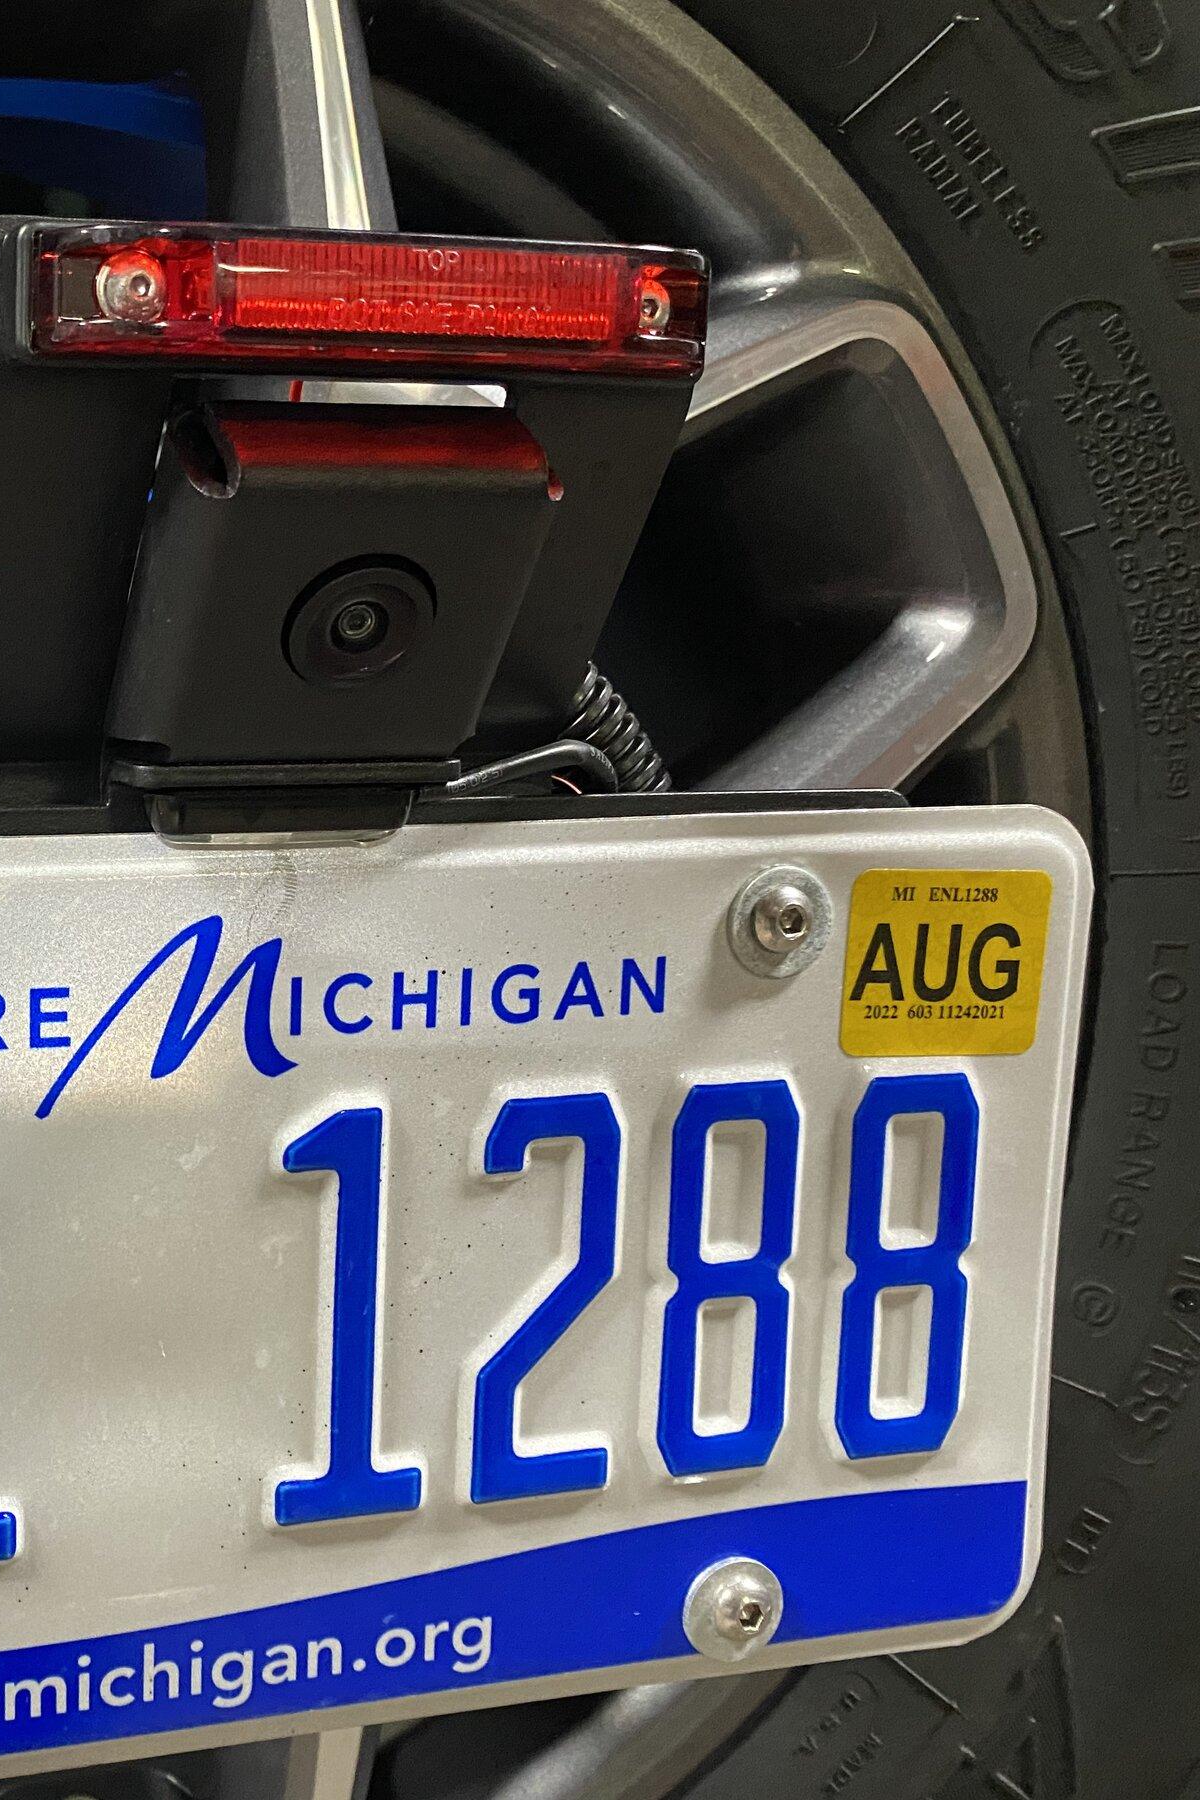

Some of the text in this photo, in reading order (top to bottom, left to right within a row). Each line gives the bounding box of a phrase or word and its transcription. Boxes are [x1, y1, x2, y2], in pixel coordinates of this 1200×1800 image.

[895, 117, 982, 224] RADIAL
[930, 91, 1047, 254] TUBELESS
[411, 248, 460, 271] TOP
[891, 886, 999, 902] MI ENL1288
[849, 922, 1022, 1003] AUG
[863, 1004, 1006, 1020] 2022 603 11242021
[1133, 939, 1194, 1073] LOAD
[35, 914, 667, 1119] MICHIGAN
[1100, 1089, 1172, 1251] RANGE
[275, 1073, 980, 1526] 1288
[3, 1615, 494, 1722] michigan.org
